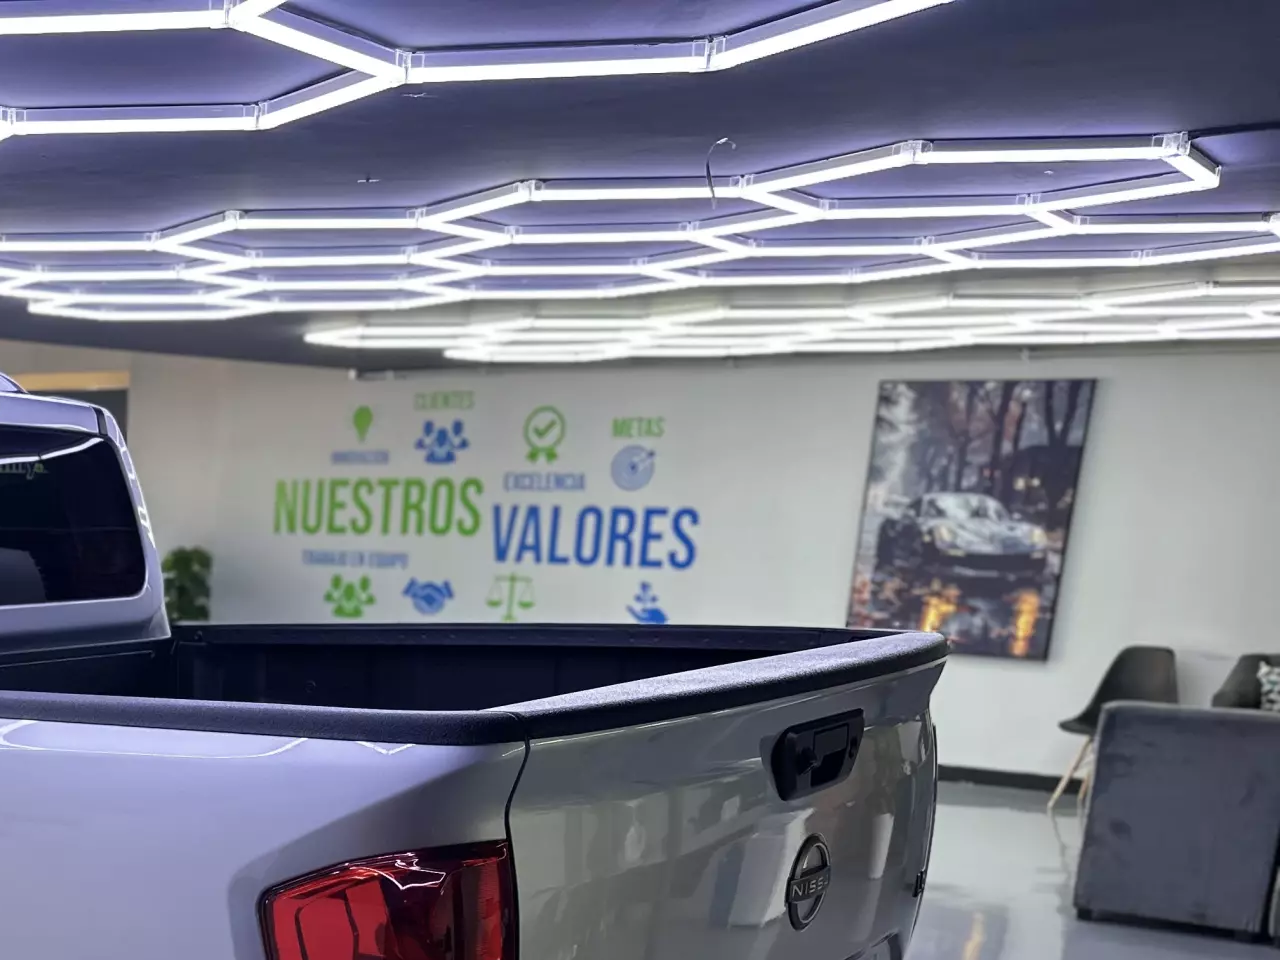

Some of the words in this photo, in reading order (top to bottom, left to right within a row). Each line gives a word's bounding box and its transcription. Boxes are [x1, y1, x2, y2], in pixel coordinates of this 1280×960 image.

[612, 417, 665, 438] METAS
[273, 476, 484, 537] NUESTROS
[492, 504, 701, 570] VALORES
